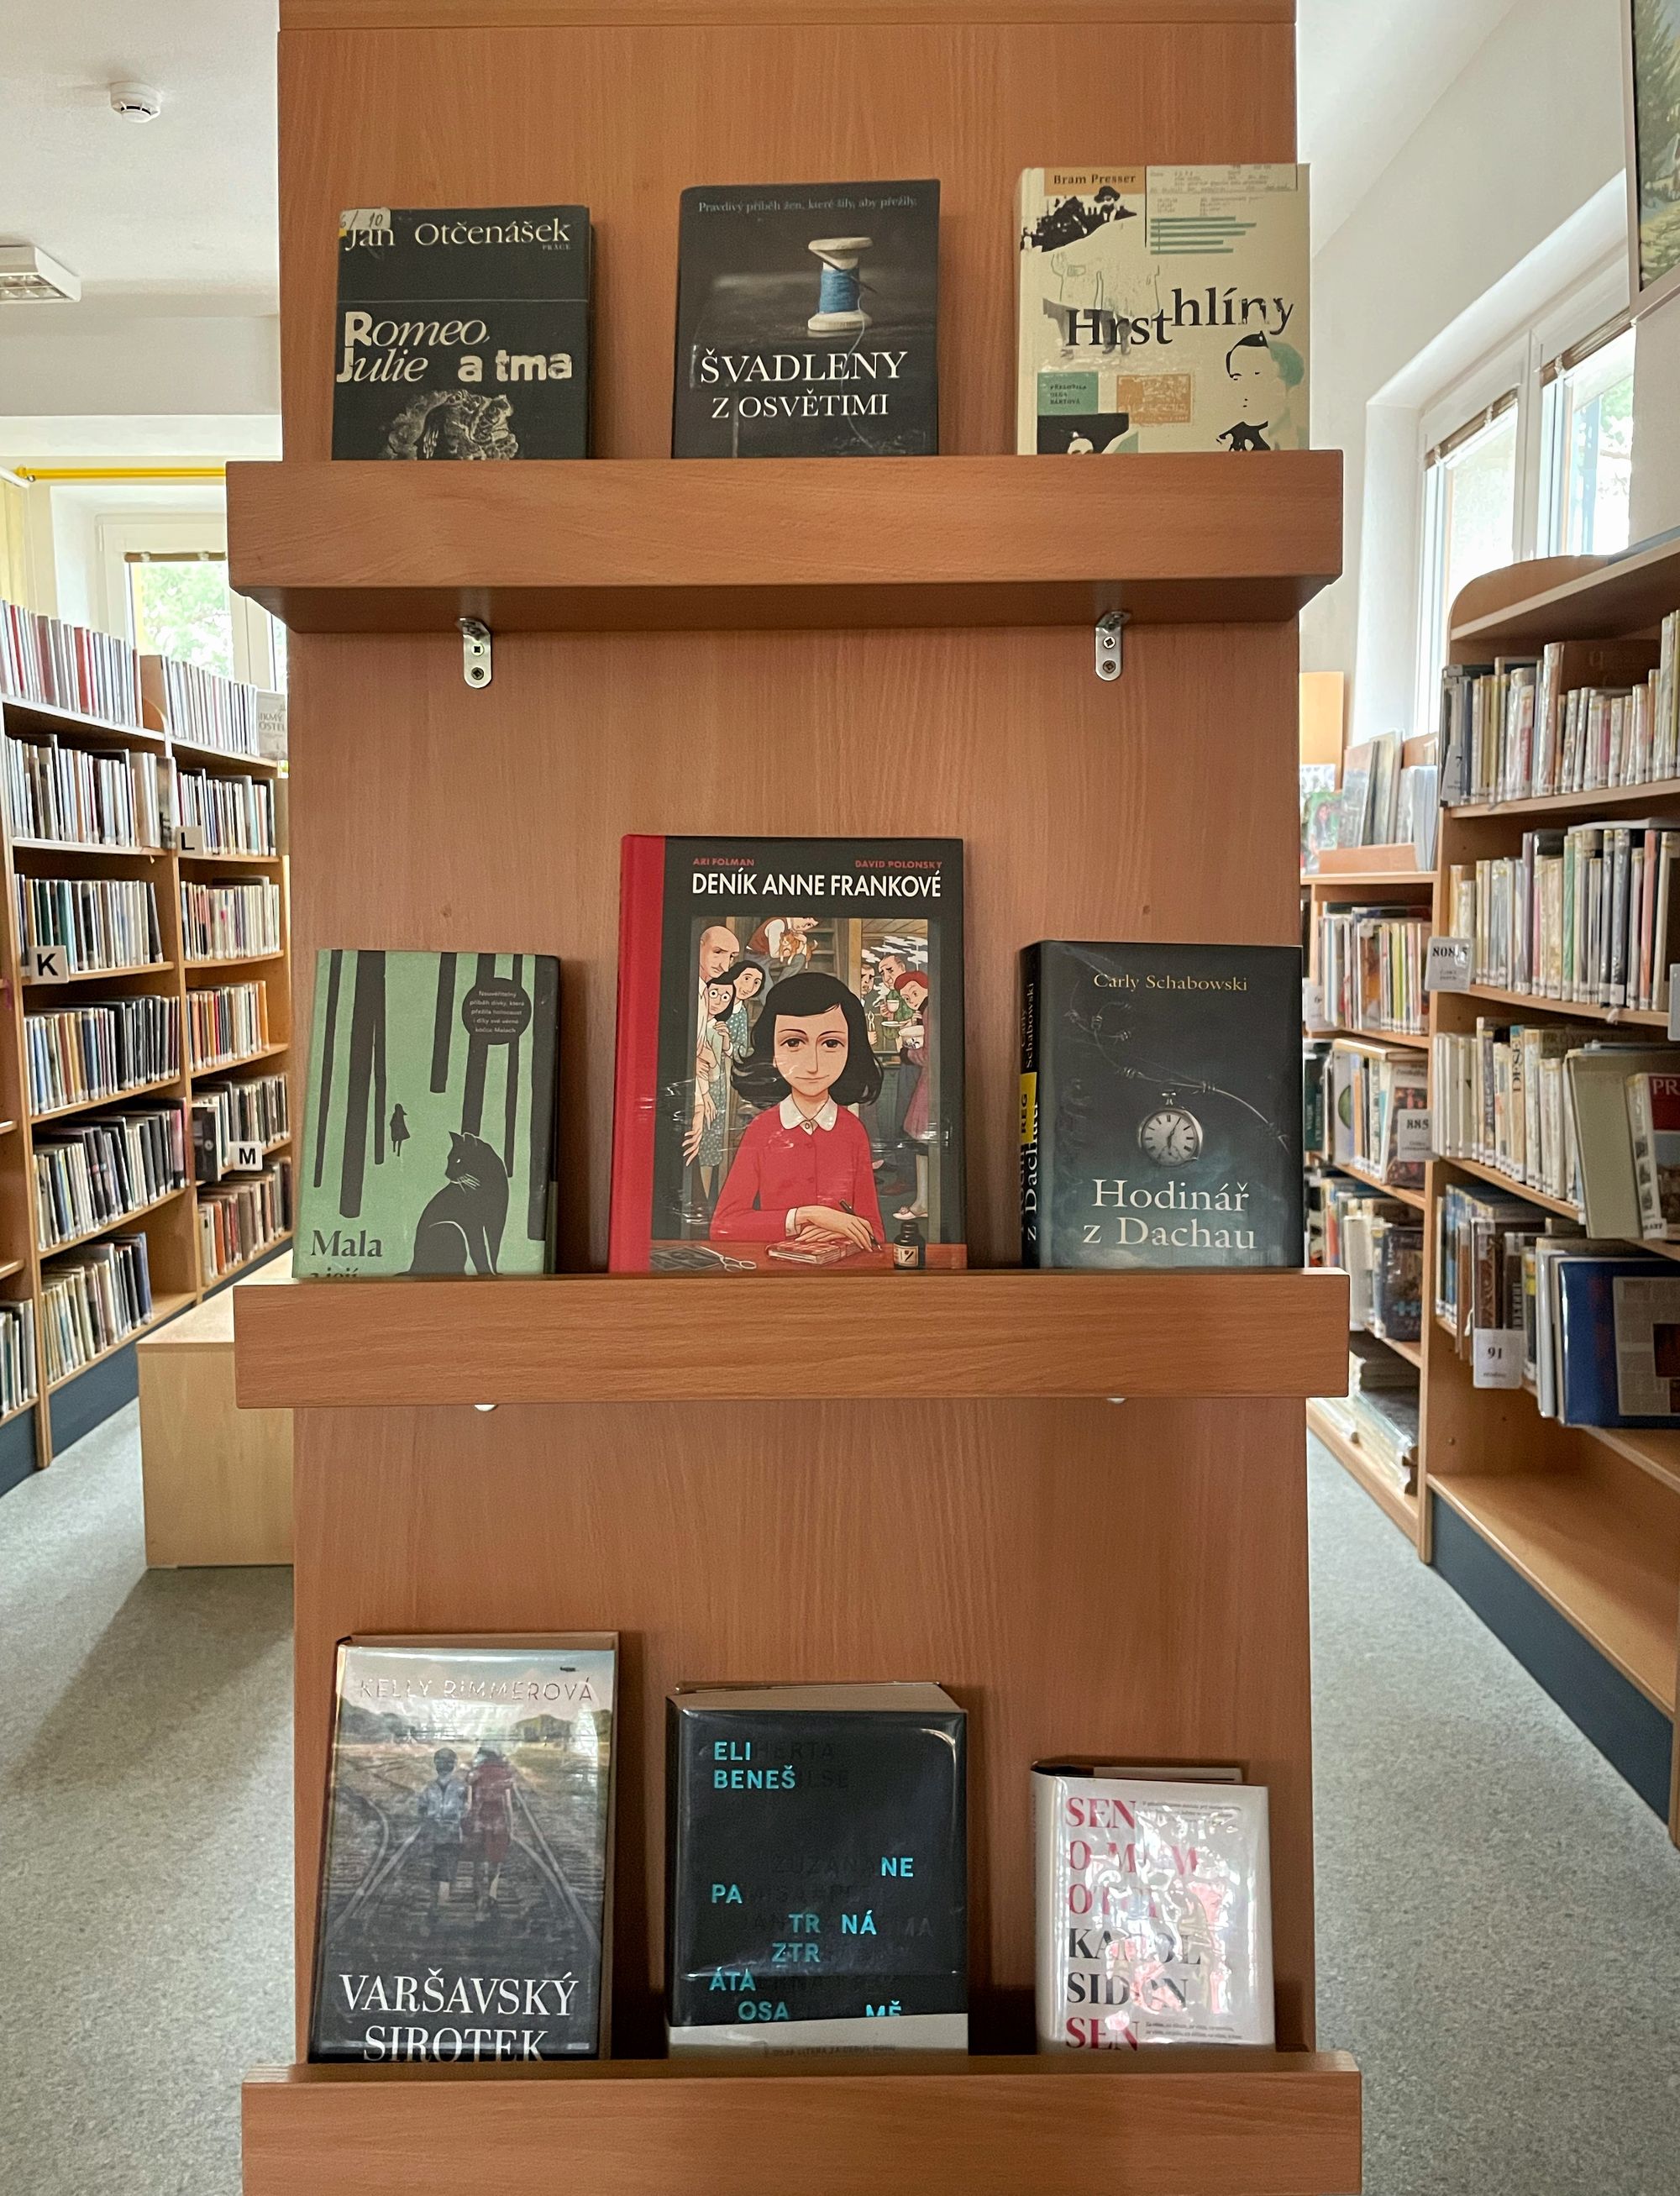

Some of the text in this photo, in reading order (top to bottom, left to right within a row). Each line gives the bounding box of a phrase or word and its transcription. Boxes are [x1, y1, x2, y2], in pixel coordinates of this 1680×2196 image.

[1053, 173, 1137, 185] Bram Presser
[858, 197, 876, 208] aby
[415, 218, 571, 245] Otčenášek
[1066, 286, 1294, 346] Hrst hlíny
[345, 312, 491, 346] Romeo,
[337, 349, 572, 382] Julie a tma
[701, 348, 907, 384] ŠVADLENY
[712, 388, 889, 418] Z OSVĚTIMI
[181, 832, 195, 850] L
[693, 858, 754, 866] ARI FOLMAN
[855, 859, 942, 869] DAVID POLONSKY
[692, 867, 942, 897] DENÍK ANNE FRANKOVÉ
[37, 954, 59, 976] K
[1094, 973, 1247, 991] Carly Schabowski
[1026, 983, 1034, 1068] Schabowski
[239, 1148, 256, 1165] M
[1091, 1179, 1249, 1212] Hodinář
[310, 1230, 383, 1257] Mala
[1083, 1216, 1257, 1249] z Dachau
[1487, 1347, 1503, 1360] 91
[360, 1677, 593, 1701] KELLY RIMMEROVÁ
[713, 1742, 752, 1761] ELI
[714, 1765, 795, 1789] BENEŠ
[1065, 1797, 1137, 1829] SEN
[880, 1857, 914, 1878] NE
[1069, 1840, 1092, 1871] O
[711, 1884, 743, 1904] PA
[788, 1914, 821, 1933] TR
[841, 1910, 877, 1935] NÁ
[771, 1943, 821, 1962] ZTR
[339, 1968, 579, 2015] VARŠAVSKÝ
[709, 1967, 756, 1991] ÁTA
[1067, 1972, 1189, 2006] SIDN
[738, 2001, 790, 2021] OSA
[363, 2025, 549, 2062] SIROTEK
[1066, 2017, 1140, 2051] SEN
